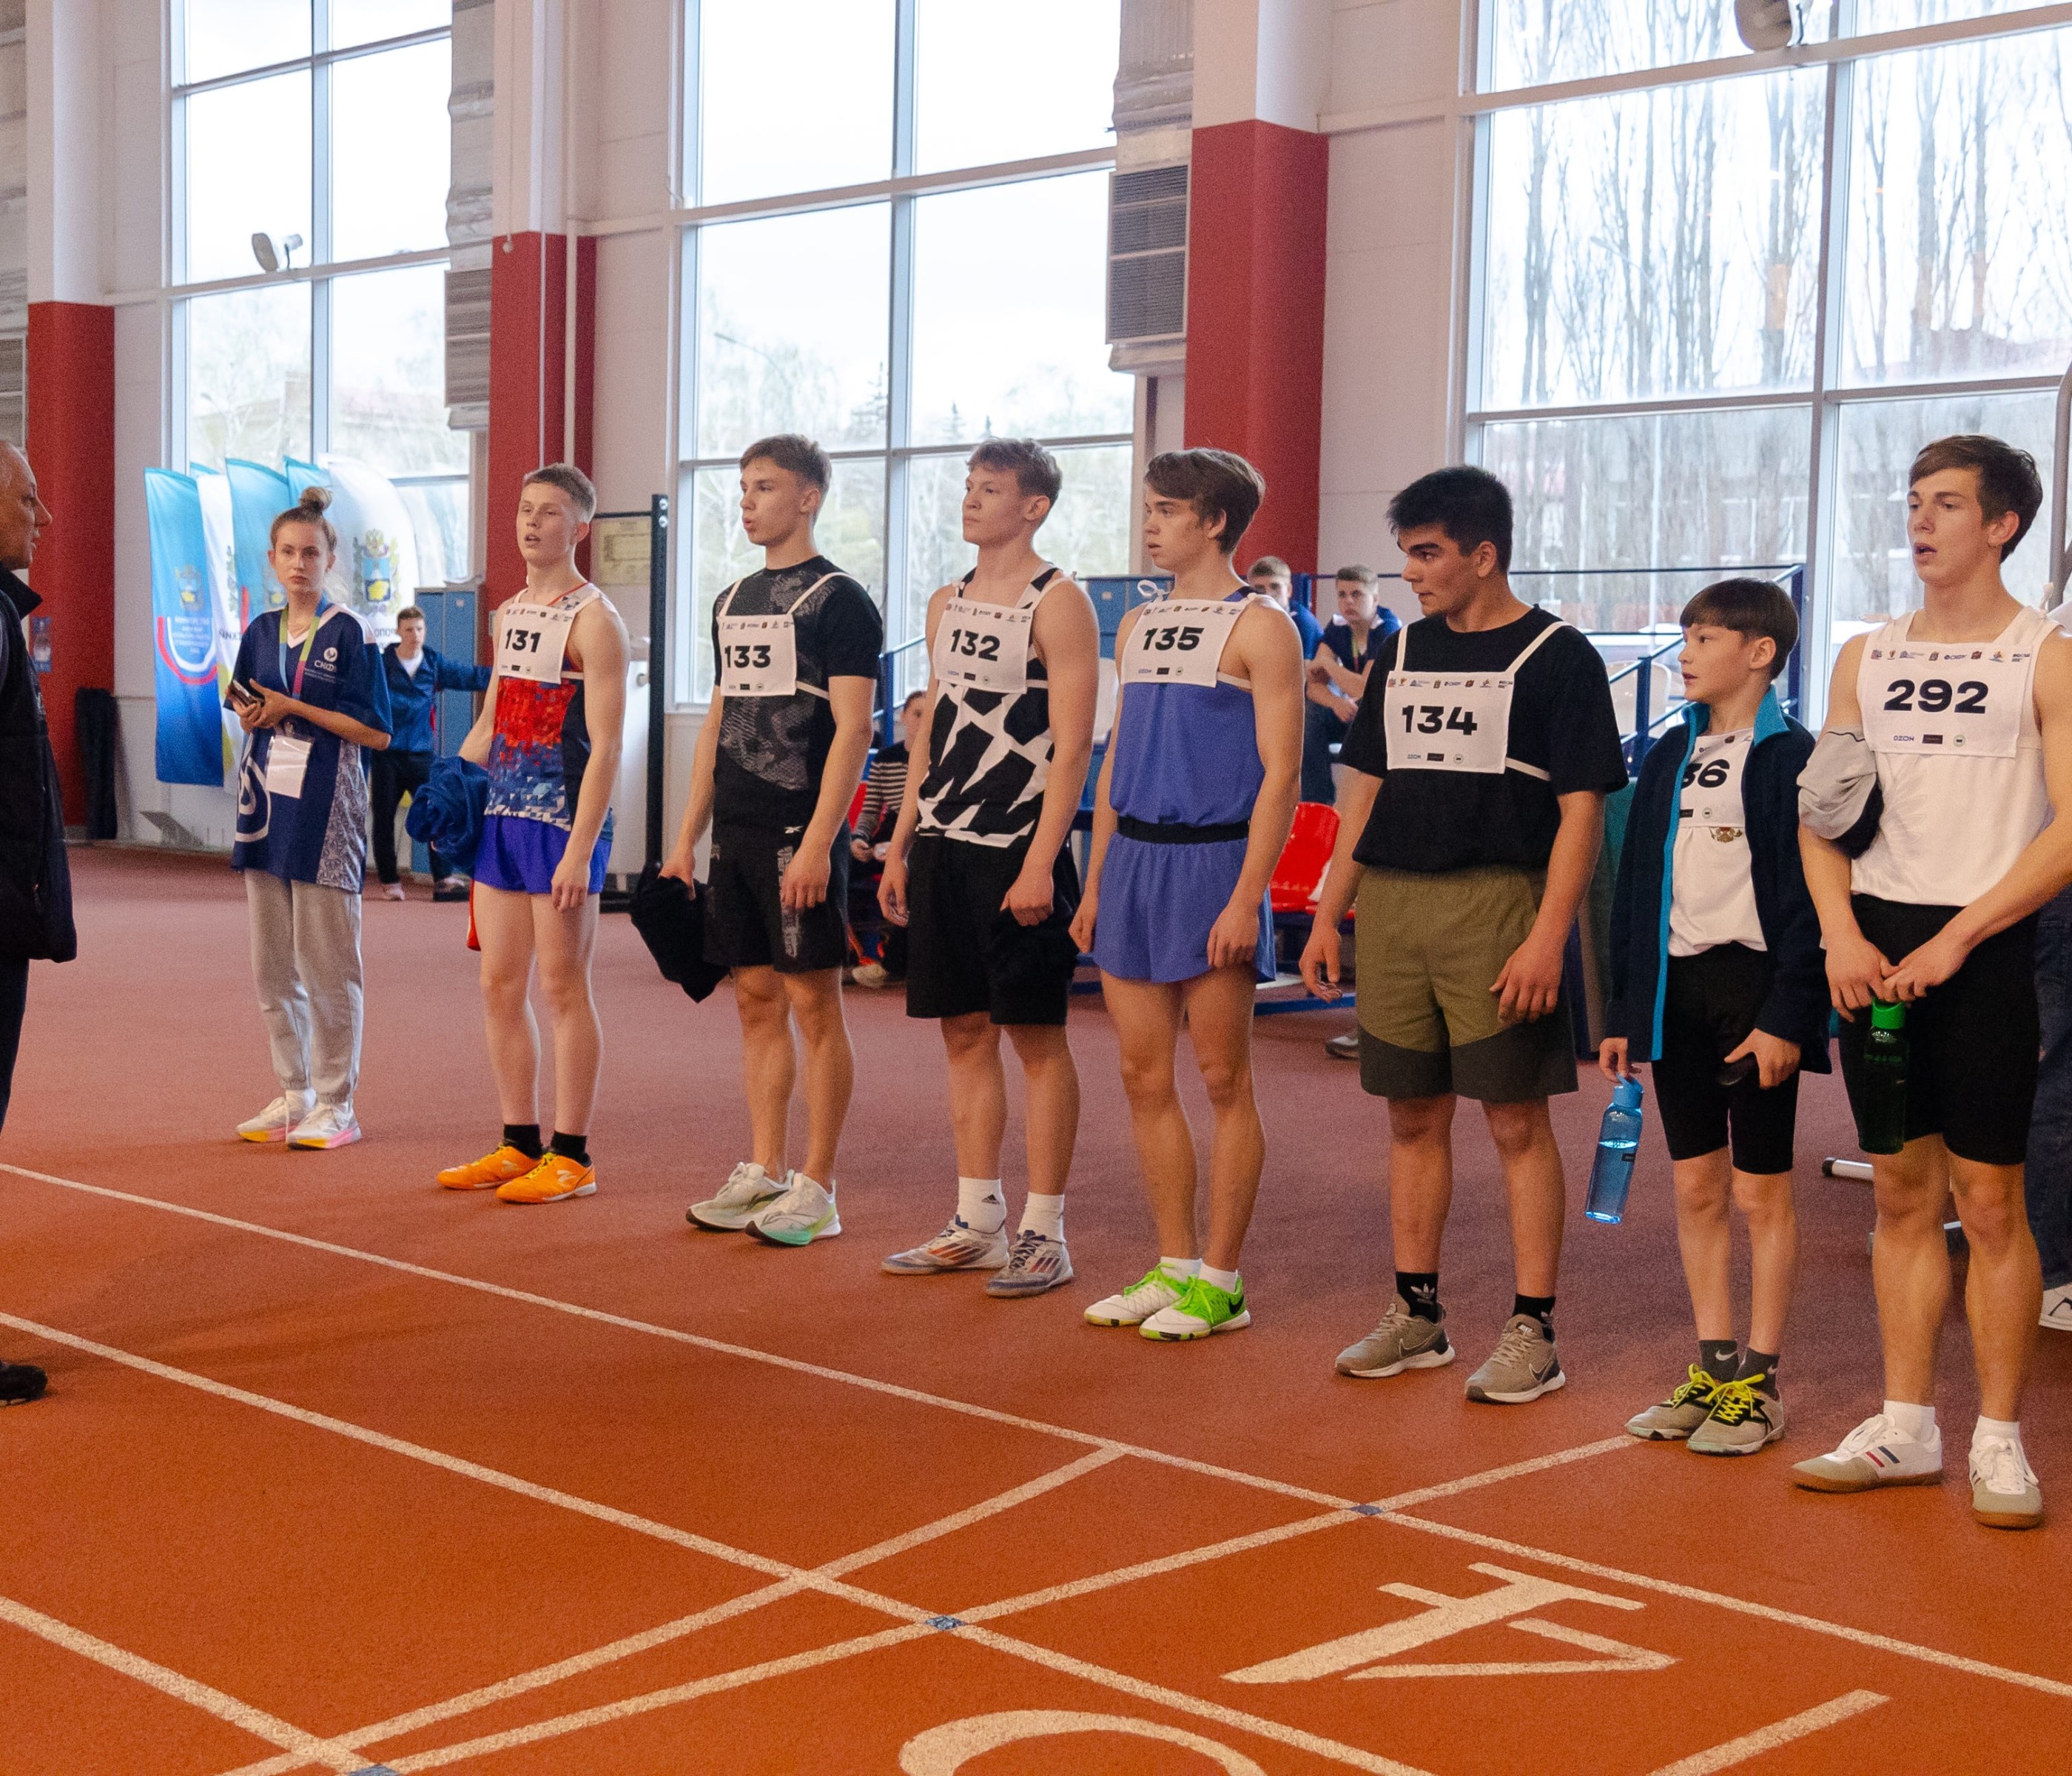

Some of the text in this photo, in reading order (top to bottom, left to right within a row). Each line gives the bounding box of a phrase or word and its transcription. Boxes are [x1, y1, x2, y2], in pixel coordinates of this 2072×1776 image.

[505, 628, 542, 653] 131
[950, 629, 1000, 662] 132
[1143, 626, 1205, 651] 135
[724, 645, 771, 668] 133
[1883, 679, 1988, 714] 292
[1402, 705, 1478, 736] 134
